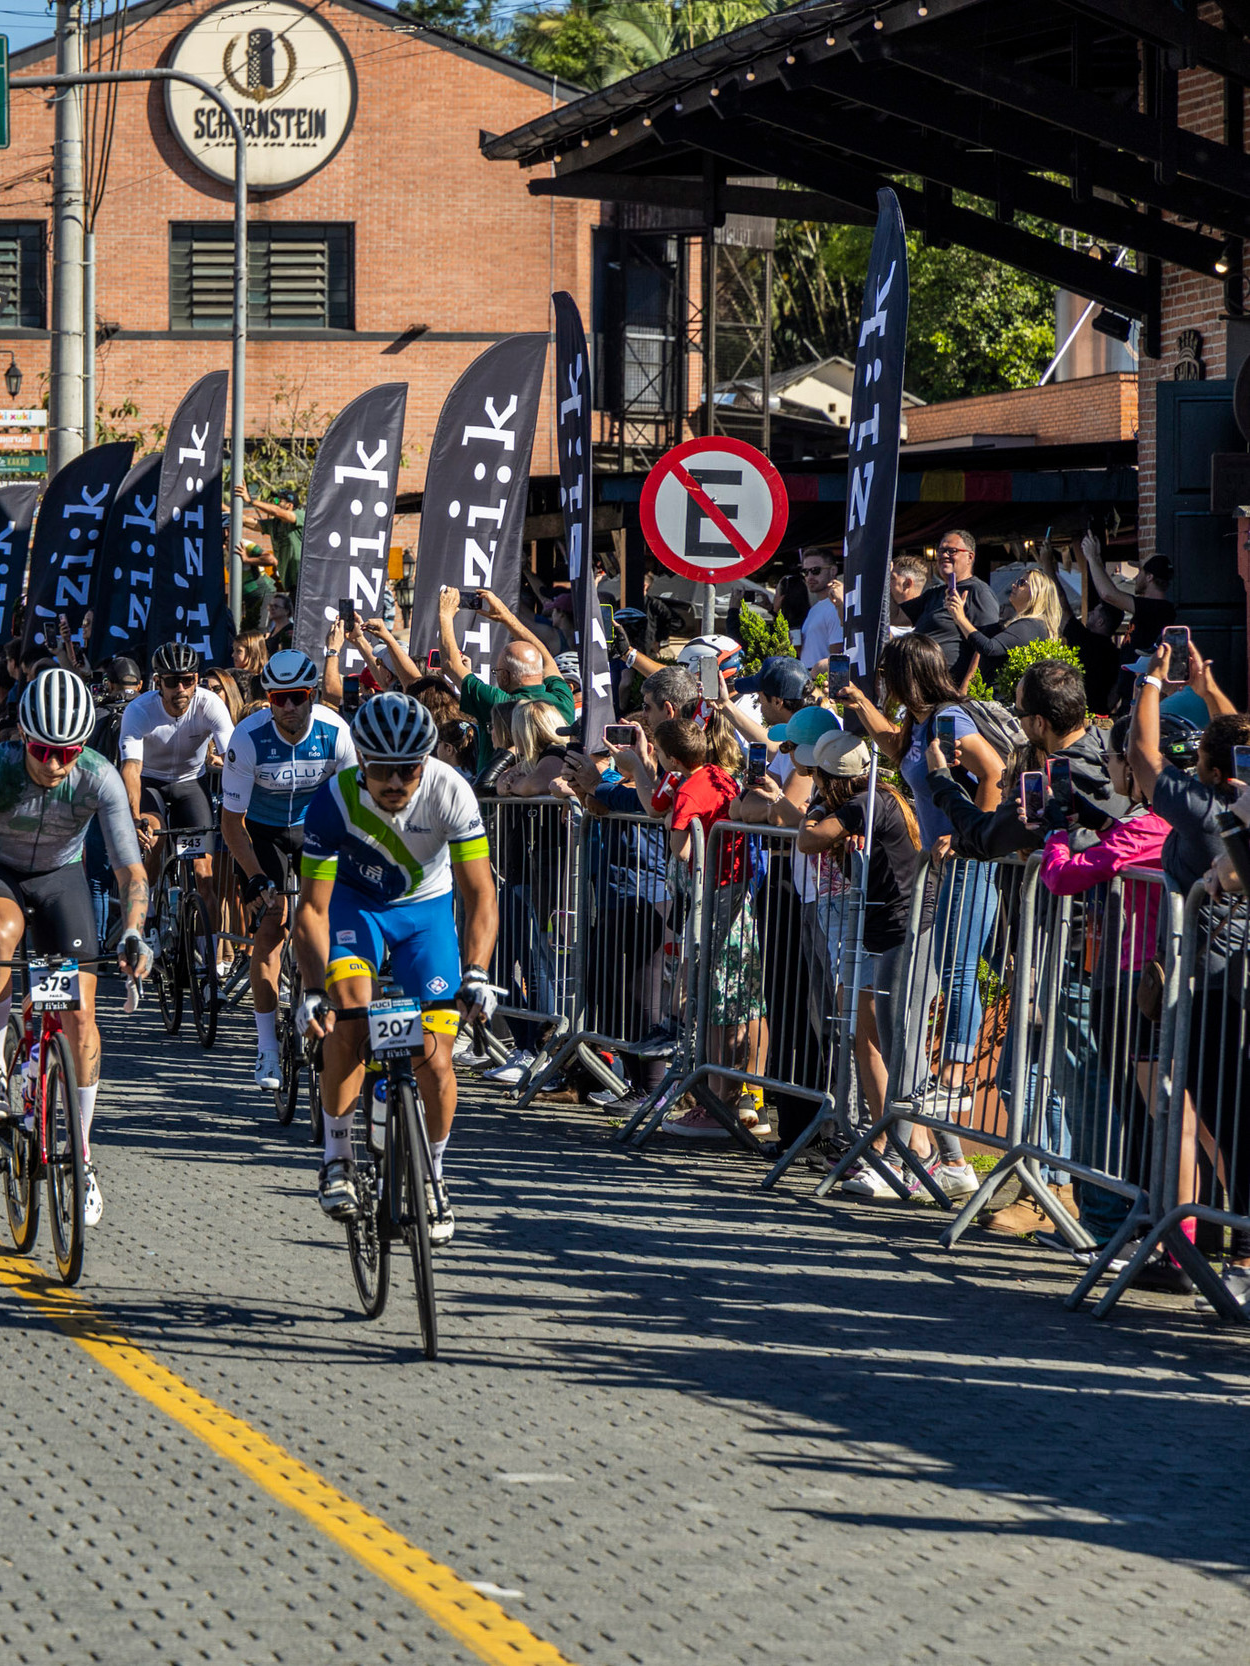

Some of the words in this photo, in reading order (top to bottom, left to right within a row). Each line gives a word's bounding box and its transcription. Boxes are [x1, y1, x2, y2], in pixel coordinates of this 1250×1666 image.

[10, 411, 32, 420] xuki
[181, 838, 201, 848] 343
[39, 976, 71, 991] 379
[377, 1001, 391, 1009] UCI
[377, 1019, 414, 1038] 207
